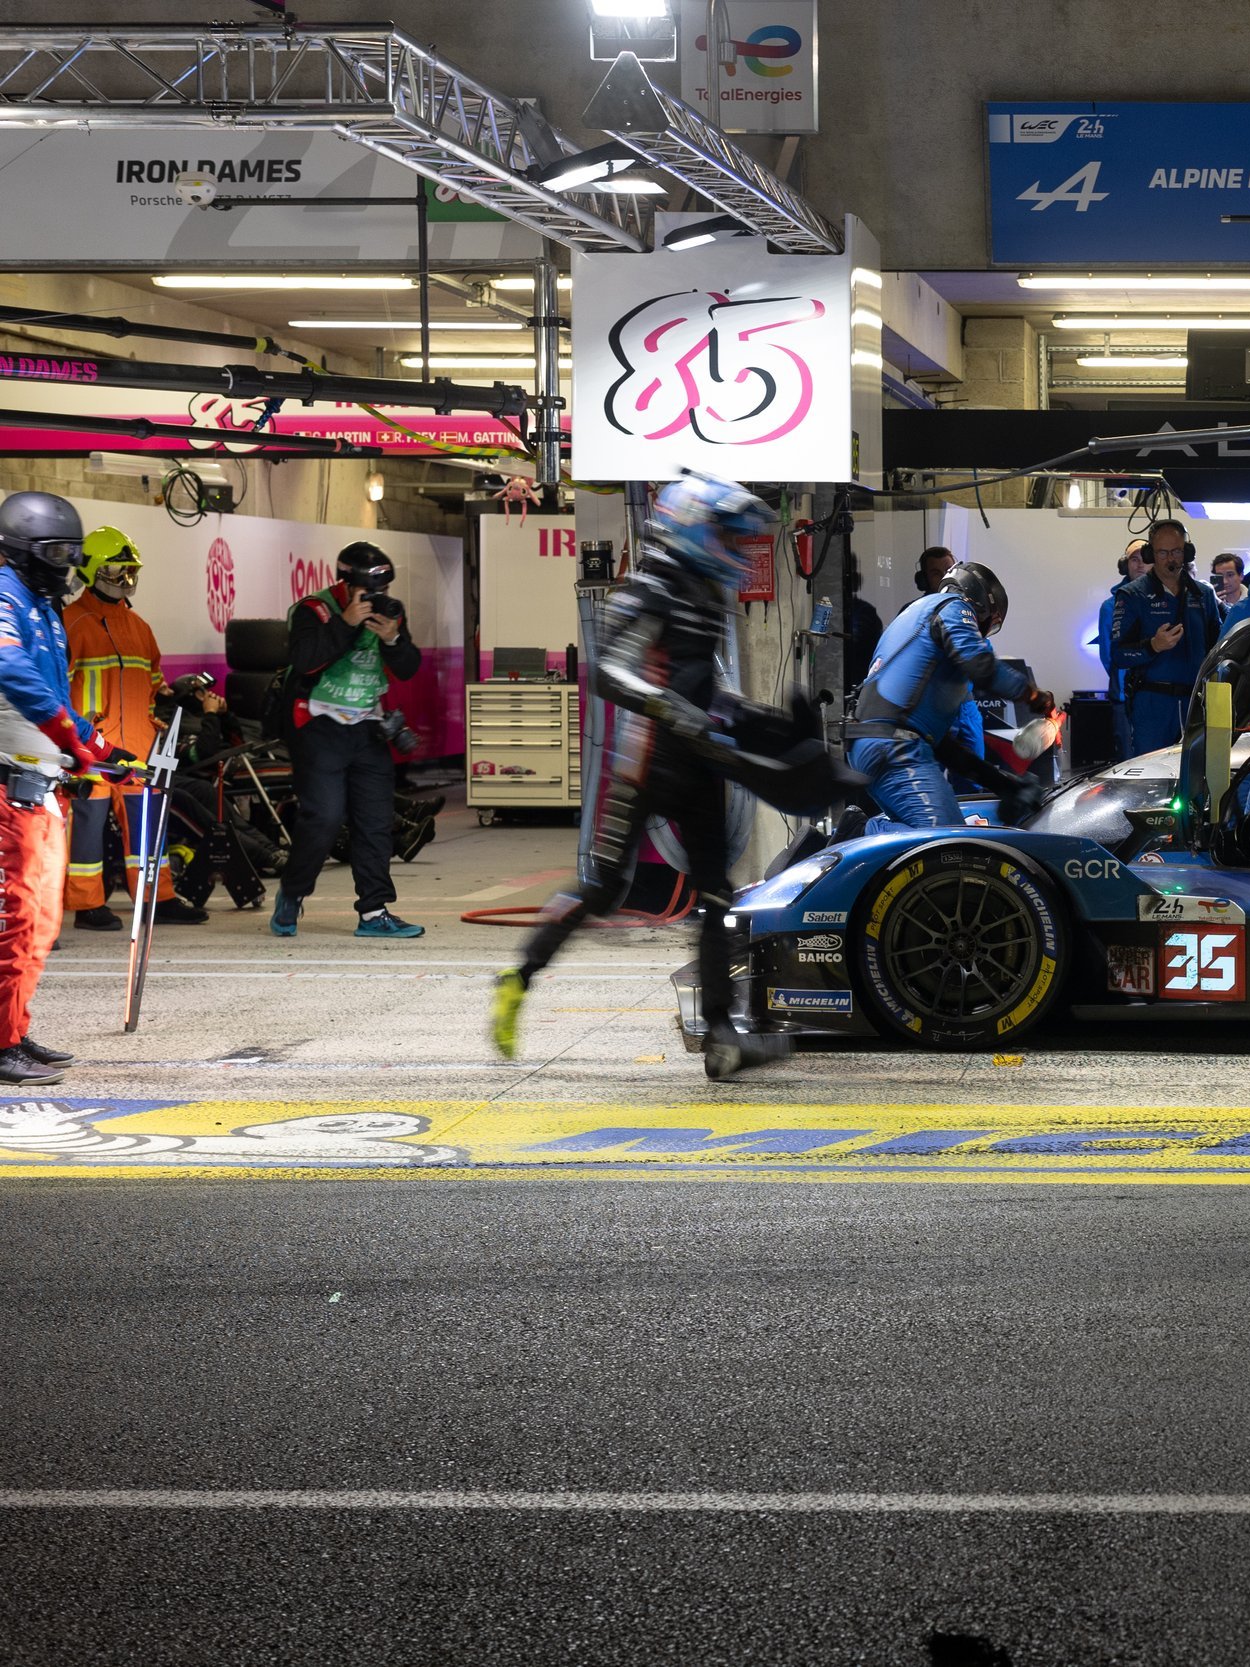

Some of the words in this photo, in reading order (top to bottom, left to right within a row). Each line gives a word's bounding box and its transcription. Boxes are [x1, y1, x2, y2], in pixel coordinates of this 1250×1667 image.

[116, 160, 188, 183] IRON
[1149, 168, 1244, 189] ALPINE
[130, 195, 183, 206] Porsche
[20, 358, 98, 383] DAMES
[603, 289, 826, 445] 85
[1146, 816, 1164, 826] elf
[1064, 859, 1121, 879] GCR
[1153, 898, 1184, 914] 24h
[807, 912, 842, 923] Sabelt
[1020, 882, 1056, 951] MICHELIN
[798, 952, 843, 963] BAHCO
[1109, 946, 1150, 965] HYPER
[1165, 932, 1238, 992] 35
[867, 944, 900, 1014] MICHELIN
[1109, 964, 1150, 991] CAR
[788, 997, 850, 1006] MICHELIN
